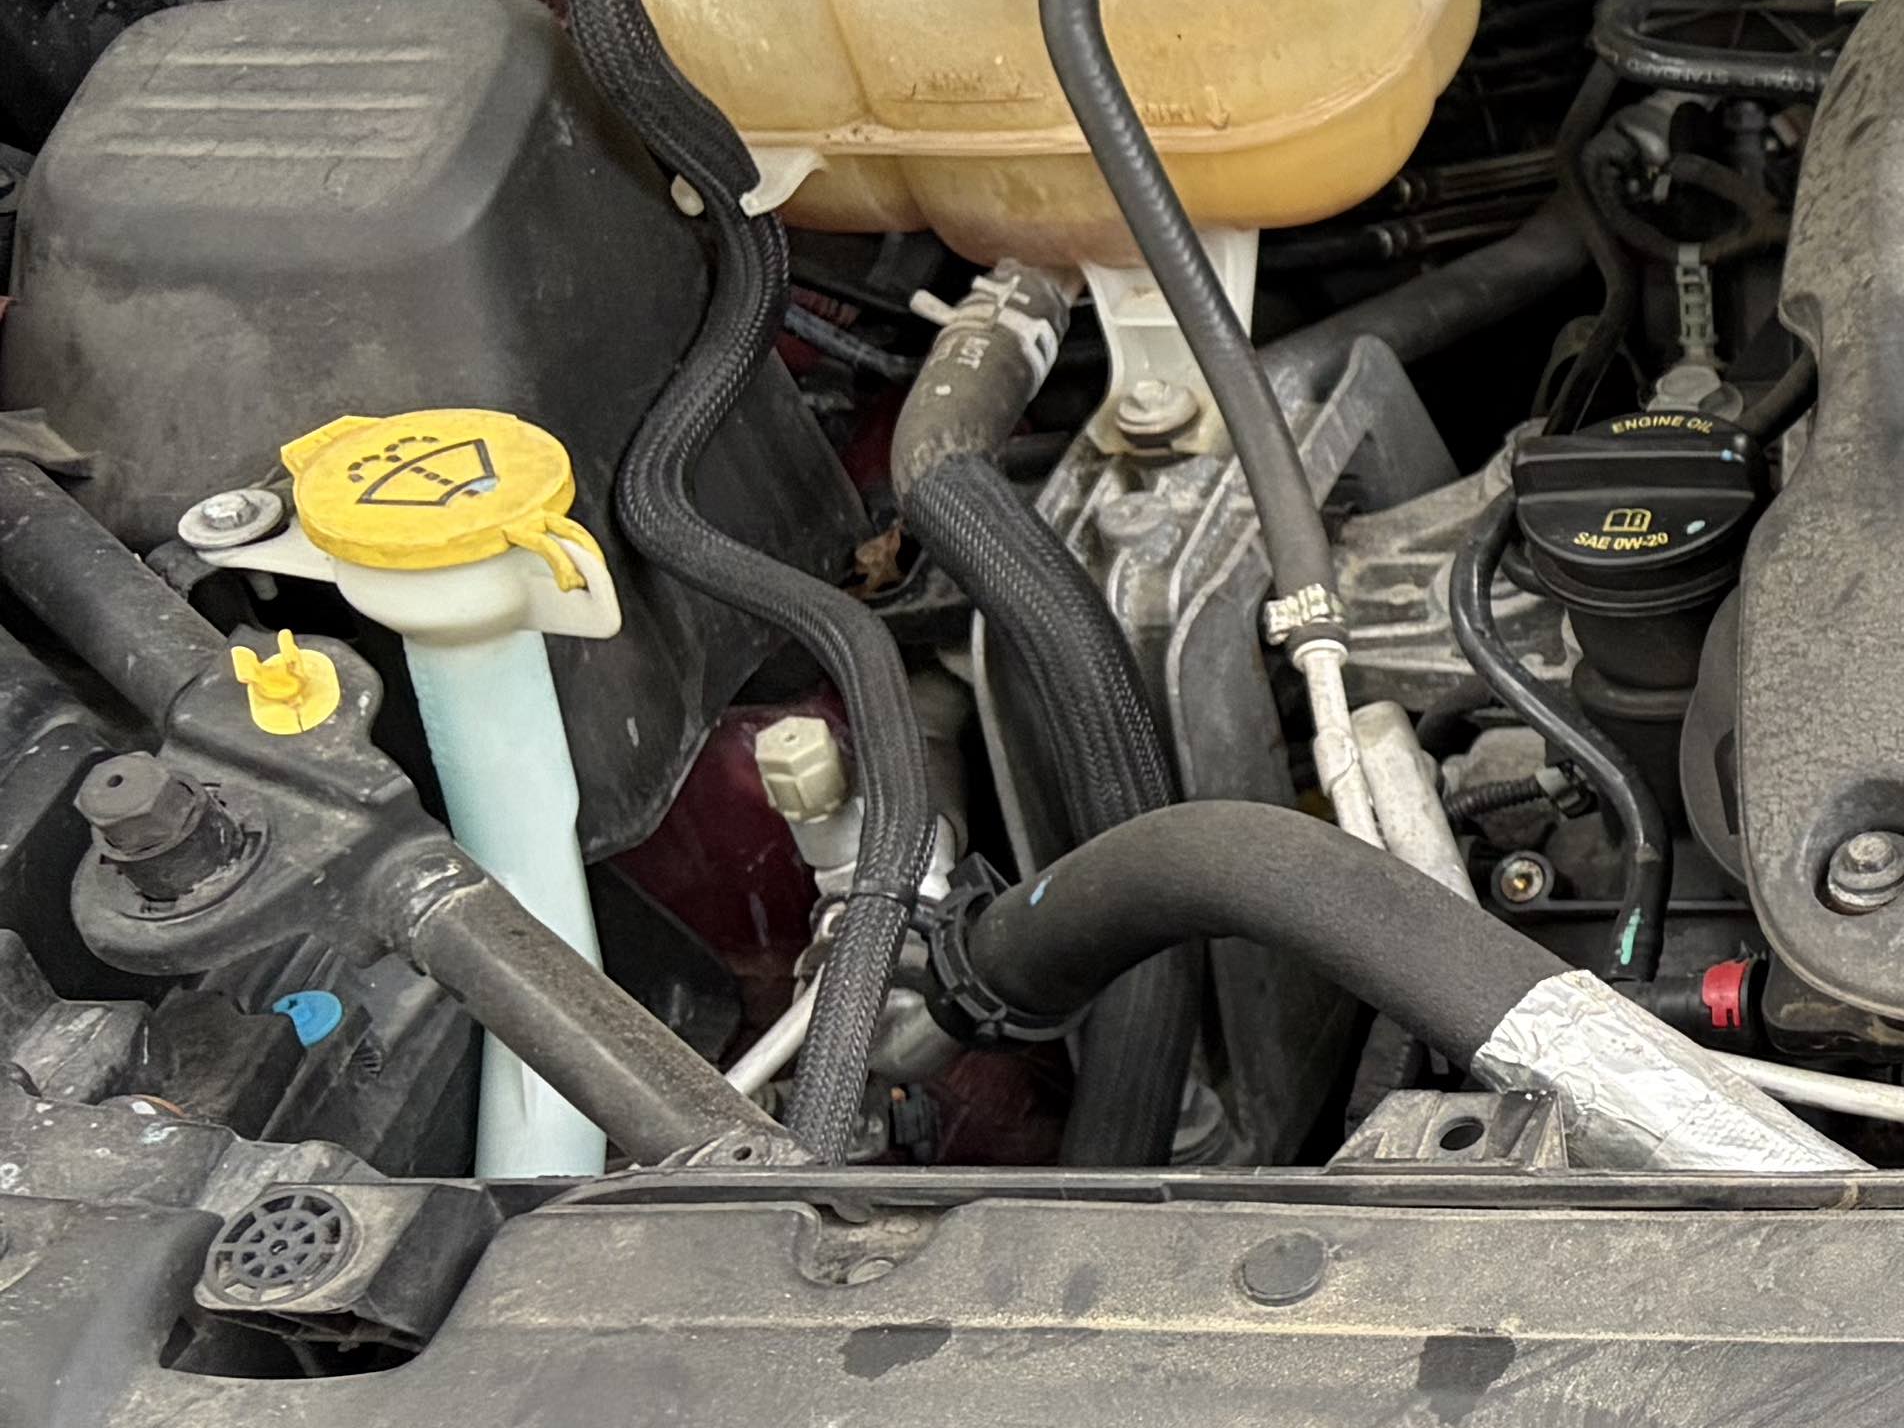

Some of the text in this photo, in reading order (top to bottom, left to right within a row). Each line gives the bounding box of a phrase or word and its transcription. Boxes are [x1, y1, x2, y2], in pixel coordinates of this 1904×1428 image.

[1612, 414, 1713, 434] ENGINE OIL
[1574, 531, 1668, 550] SAE 0W-20
